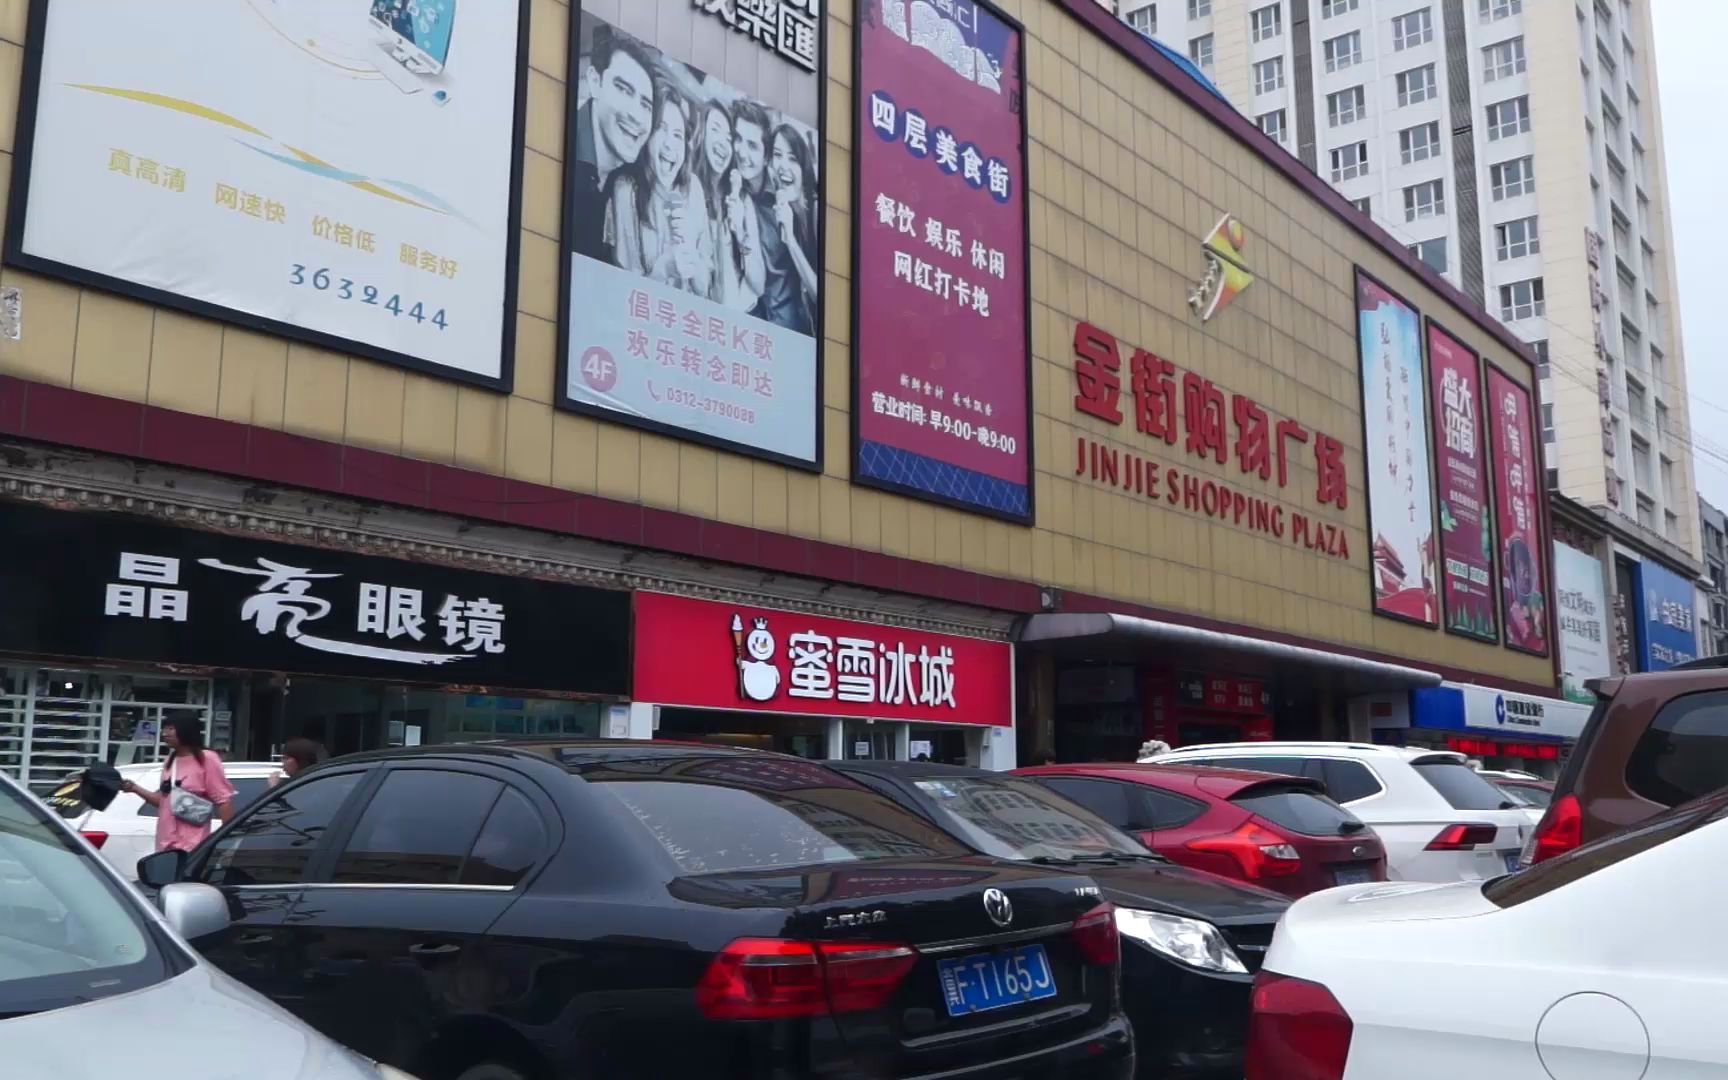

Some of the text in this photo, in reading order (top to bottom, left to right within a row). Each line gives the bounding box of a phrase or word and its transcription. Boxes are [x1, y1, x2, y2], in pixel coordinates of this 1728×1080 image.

[871, 93, 1009, 198] 四层美食街
[107, 147, 459, 280] 真高清 网速快 价格低 服务好
[875, 193, 1005, 279] 餐饮 娱乐 休闲
[289, 263, 450, 331] 3632444
[628, 289, 773, 361] 倡导全民K歌
[894, 250, 990, 318] 网红打卡地
[583, 354, 613, 382] 4F
[627, 330, 773, 397] 欢乐转念即达
[1074, 321, 1348, 511] 金街购物广场
[1075, 437, 1350, 560] JINJIE SHOPPING PLAZA
[104, 551, 506, 664] 晶亮眼镜
[788, 629, 956, 709] 蜜雪冰城
